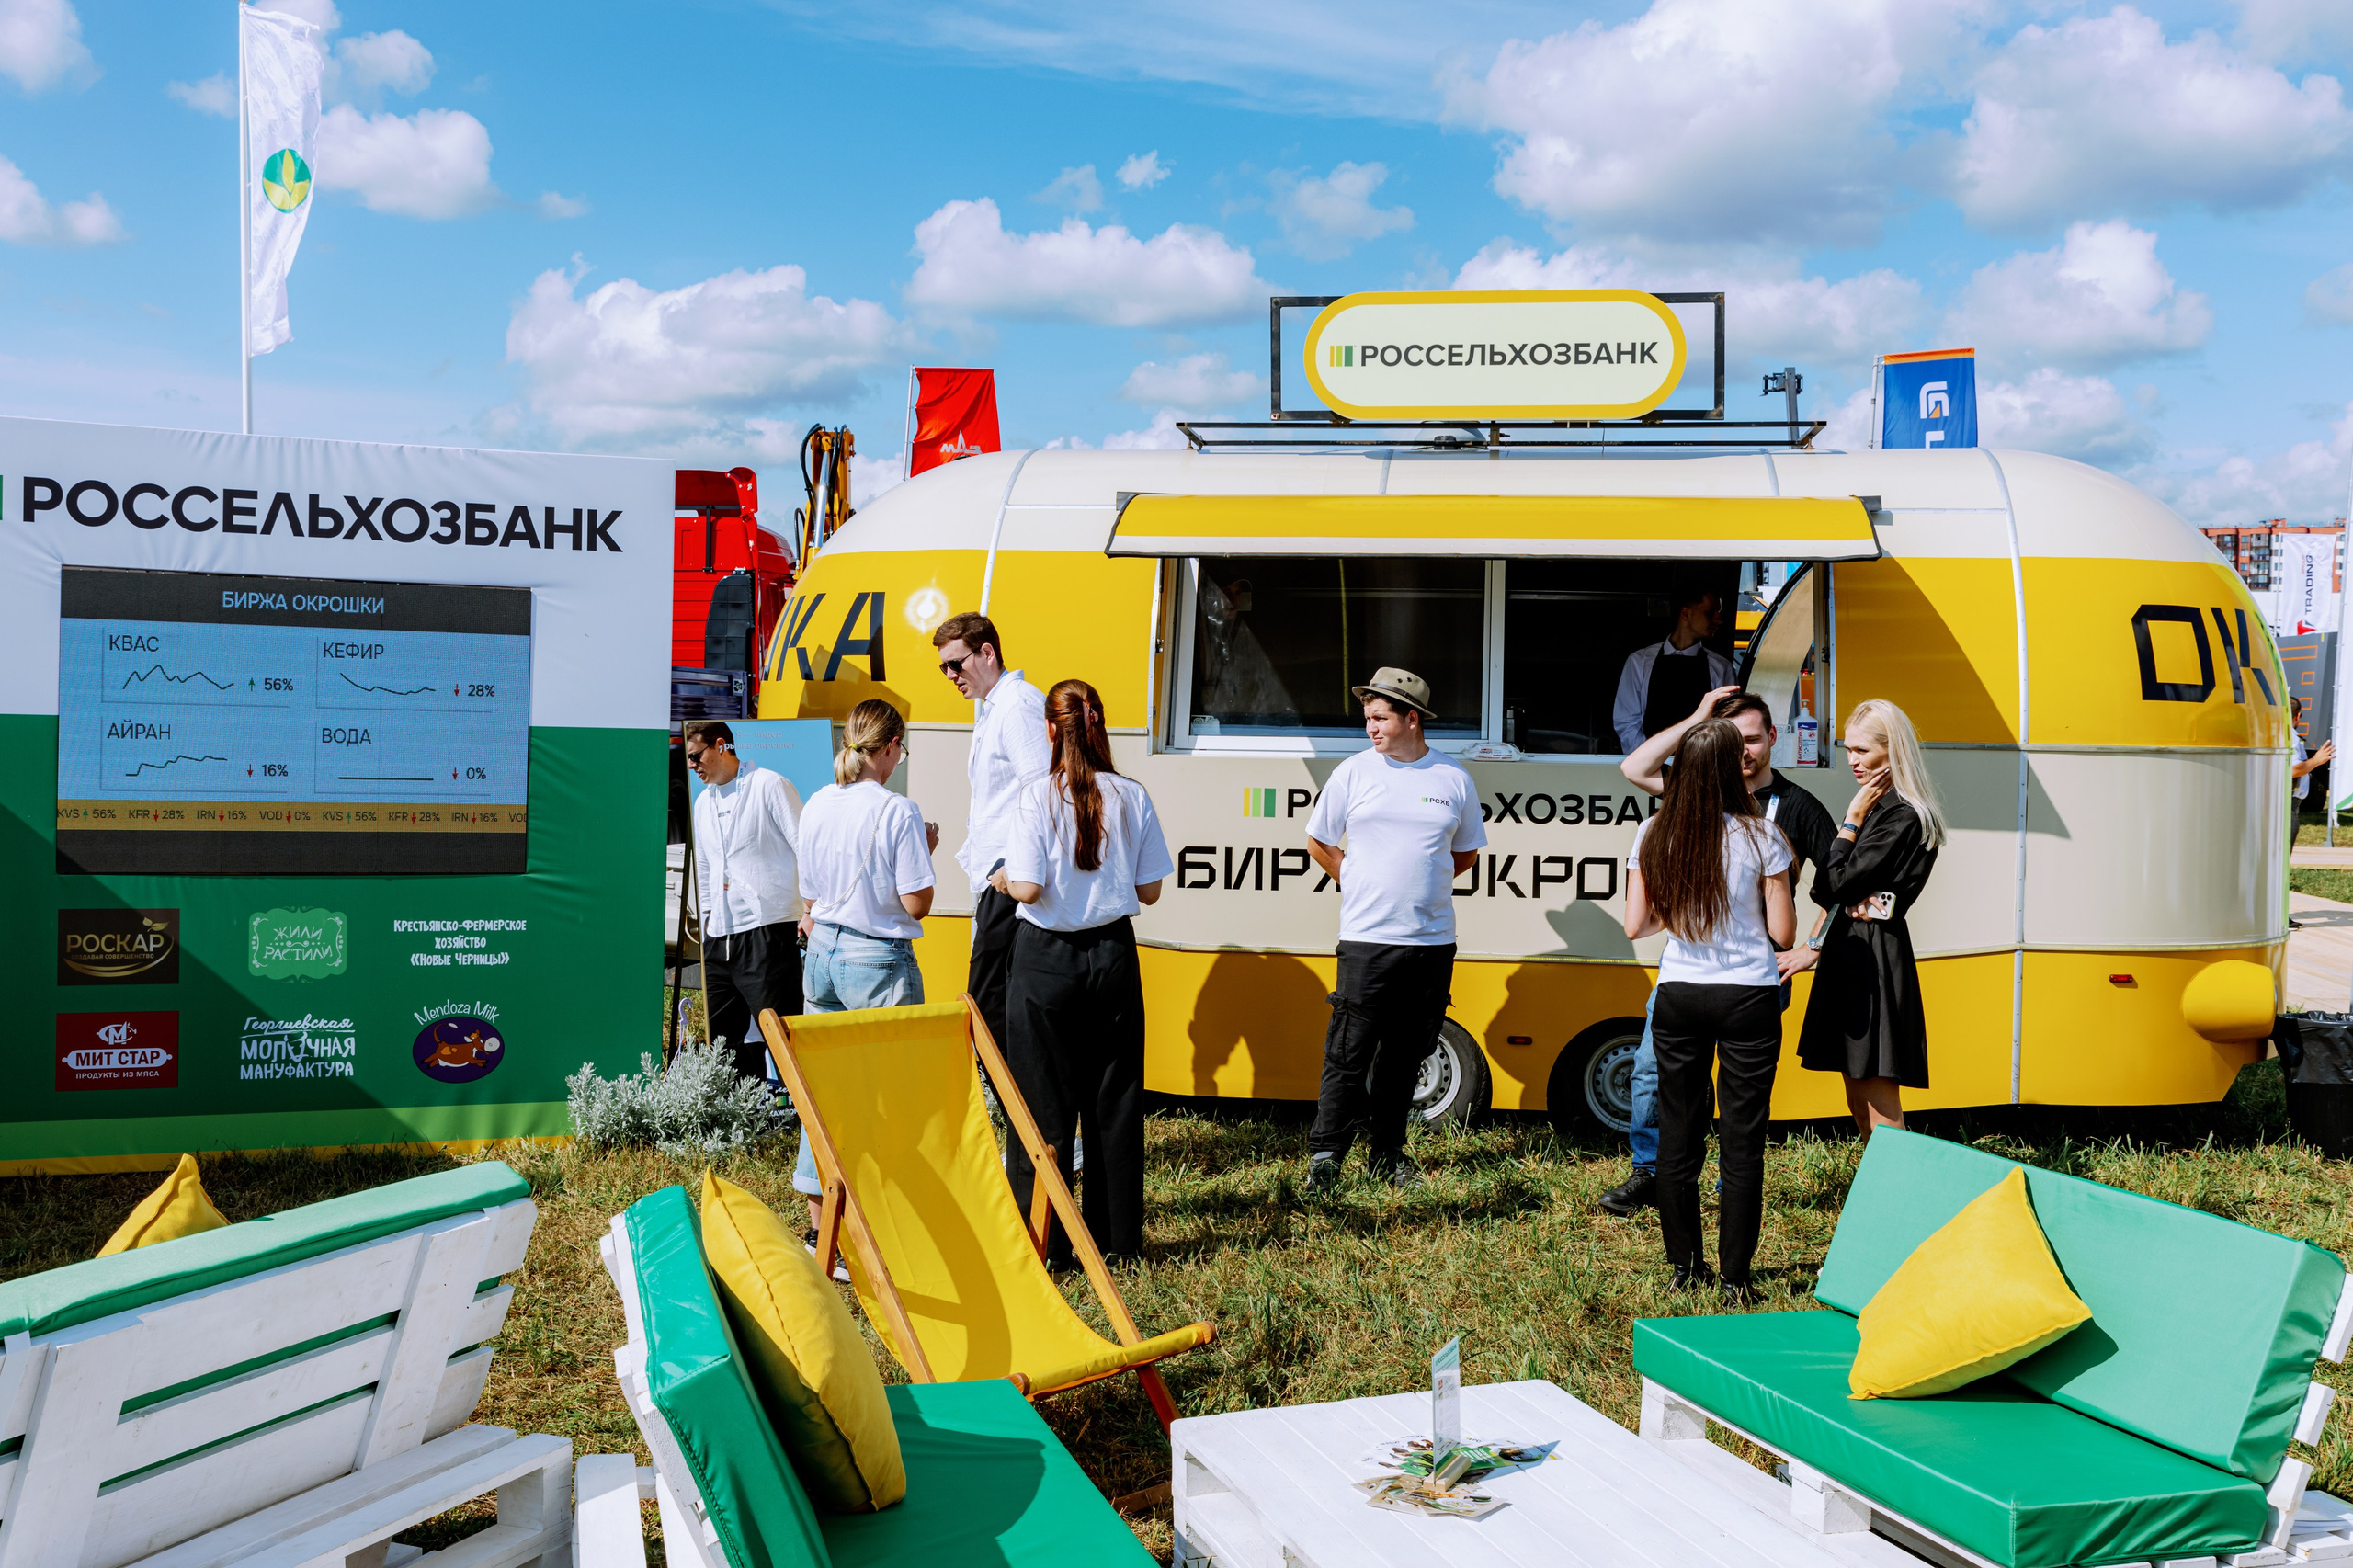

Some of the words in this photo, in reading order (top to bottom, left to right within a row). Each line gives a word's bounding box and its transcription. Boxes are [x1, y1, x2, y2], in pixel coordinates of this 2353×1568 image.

[1360, 341, 1658, 367] РОССЕЛЬХОЗБАНК
[22, 475, 624, 553] РОССЕЛЬХОЗБАНК
[2305, 554, 2314, 616] TRADING
[222, 590, 289, 611] БИРЖА
[292, 594, 385, 615] ОКРОШКИ
[108, 634, 160, 653] КВАС
[323, 642, 384, 660] КЕФИР
[264, 677, 294, 692] 56%
[467, 684, 495, 698] 28%
[107, 718, 171, 740] АЙРАН
[322, 727, 372, 747] ВОДА
[261, 764, 289, 778] 16%
[466, 767, 487, 780] 0%
[1429, 797, 1450, 807] РСХБ
[92, 809, 117, 820] 56%
[128, 809, 151, 820] KFR
[162, 810, 185, 820] 28%
[197, 810, 216, 820] IRN
[227, 810, 248, 820] 16%
[259, 811, 283, 821] VOD
[294, 811, 311, 822] 0%
[323, 811, 344, 821] KVS
[355, 812, 377, 822] 56%
[388, 812, 408, 822] KFR
[419, 812, 441, 822] 28%
[451, 812, 469, 823] IRN
[479, 812, 498, 823] 16%
[274, 926, 322, 941] ЖИЛИ
[66, 933, 165, 953] РОСКАР
[263, 945, 333, 960] РАСТИЛИ
[414, 999, 471, 1026] Mendoza
[473, 1000, 499, 1024] Milk
[243, 1013, 354, 1035] Георгиевская
[75, 1051, 114, 1067] МИТ
[118, 1050, 161, 1065] СТАР
[75, 1072, 120, 1080] ПРОДУКТЫ
[136, 1070, 160, 1078] МЯСА
[240, 1061, 354, 1080] МАНУФАКТУРА
